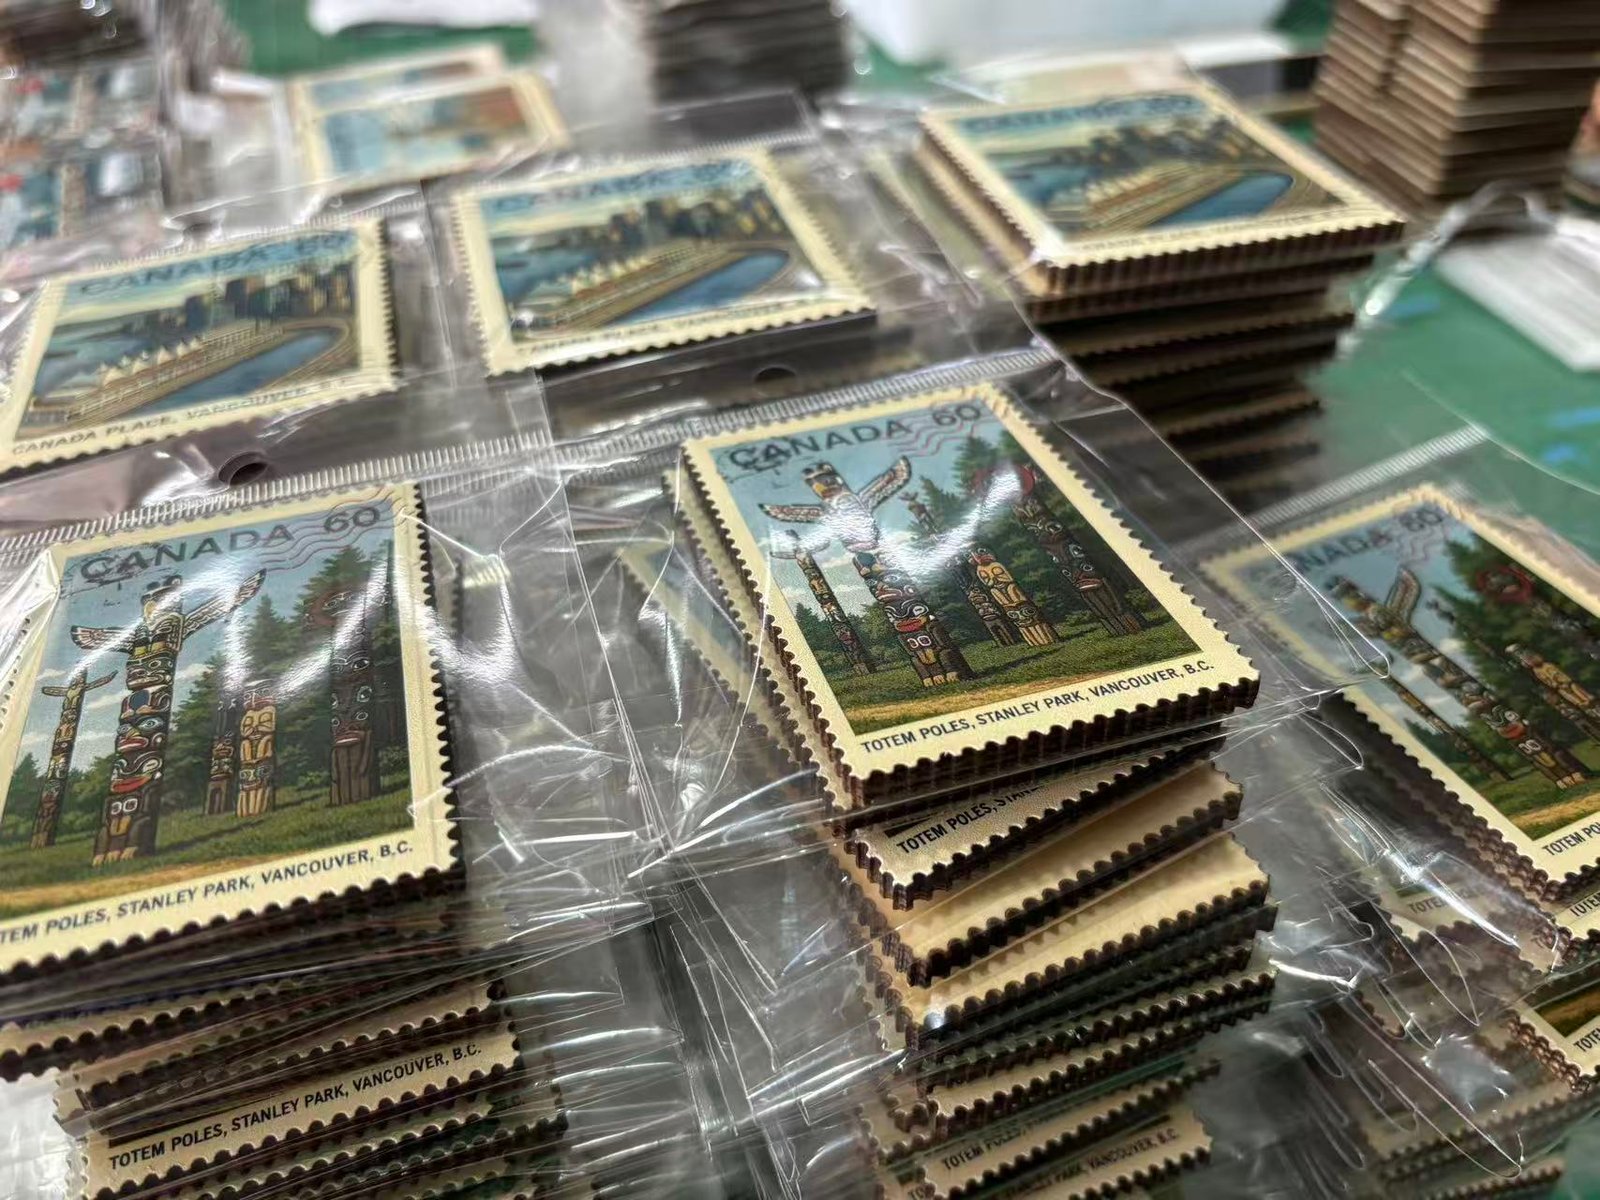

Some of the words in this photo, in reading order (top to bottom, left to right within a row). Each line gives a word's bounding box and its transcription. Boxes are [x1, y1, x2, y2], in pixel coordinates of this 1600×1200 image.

[12, 430, 97, 455] CANADA
[729, 418, 914, 468] CANADA
[932, 402, 982, 427] 60
[80, 523, 294, 582] CANADA
[323, 506, 381, 535] 60
[861, 731, 917, 754] TOTEM
[919, 718, 976, 740] POLES,
[976, 700, 1041, 725] STANLEY
[1043, 690, 1090, 710] PARK,
[1089, 668, 1185, 697] VANCOUVER,
[1183, 660, 1215, 675] B.C.
[896, 823, 949, 854] TOTEM
[945, 801, 998, 831] POLES,
[1542, 831, 1587, 856] TOTEM
[0, 922, 40, 945] TEM
[46, 907, 112, 935] POLES,
[117, 886, 198, 918] STANLEY
[203, 875, 256, 898] PARK,
[261, 848, 375, 885] VANCOUVER,
[379, 840, 413, 858] B.C.
[109, 1138, 166, 1170] TOTEM
[171, 1122, 228, 1152] POLES,
[231, 1096, 300, 1132] STANLEY
[304, 1083, 349, 1109] PARK,
[352, 1052, 450, 1093] VANCOUVER,
[452, 1043, 482, 1062] B.C.
